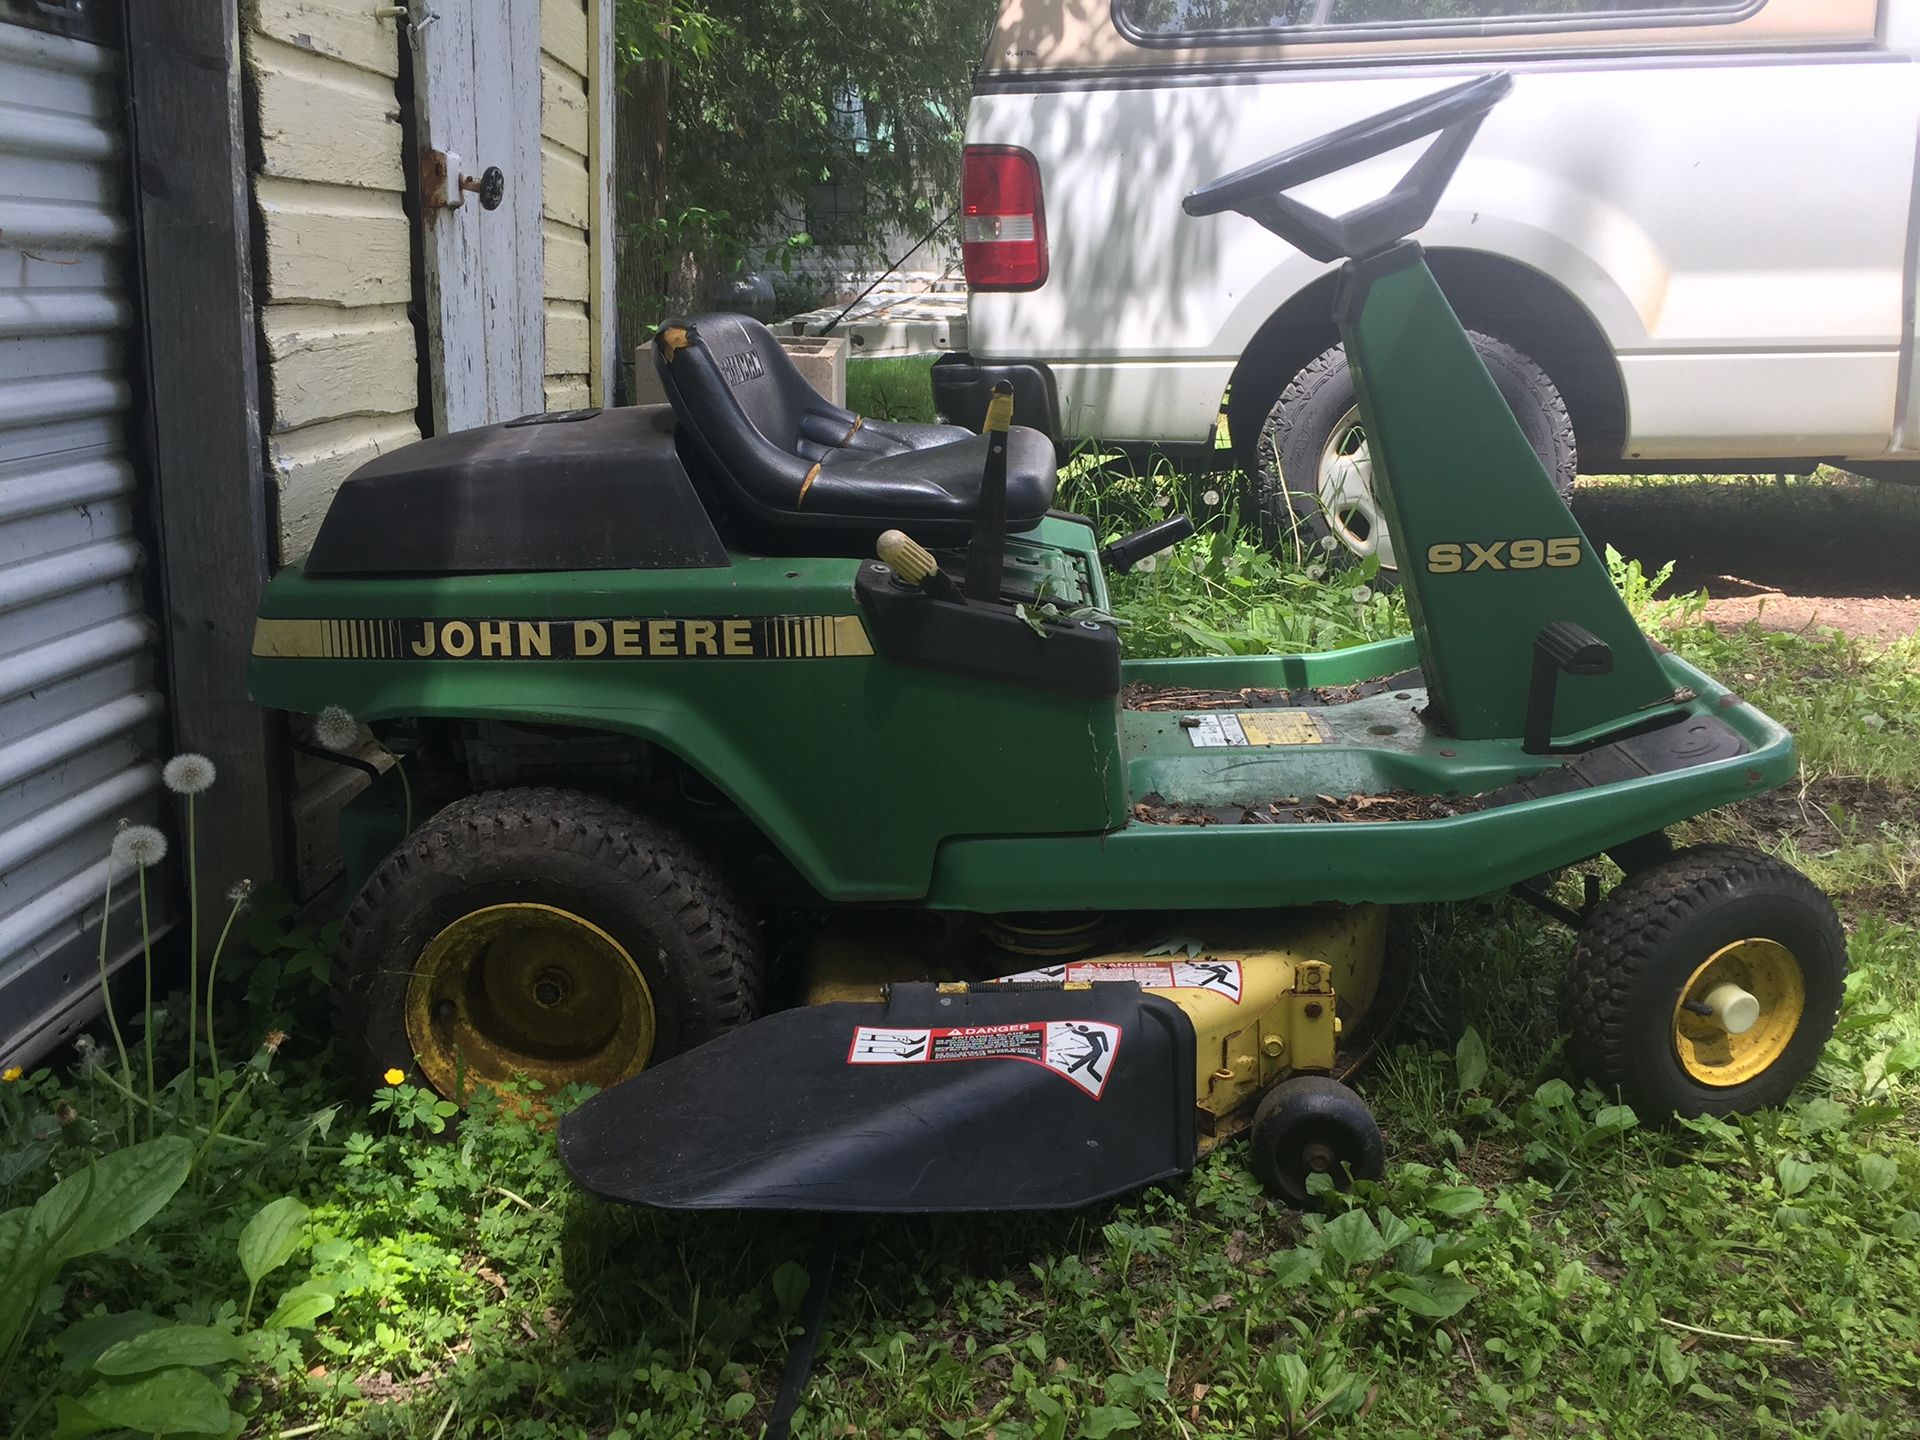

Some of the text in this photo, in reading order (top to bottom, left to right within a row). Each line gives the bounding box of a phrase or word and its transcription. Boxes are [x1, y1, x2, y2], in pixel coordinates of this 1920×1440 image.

[1427, 536, 1582, 573] SX95
[411, 619, 754, 657] JOHN DEERE
[965, 1024, 1030, 1034] DANGER
